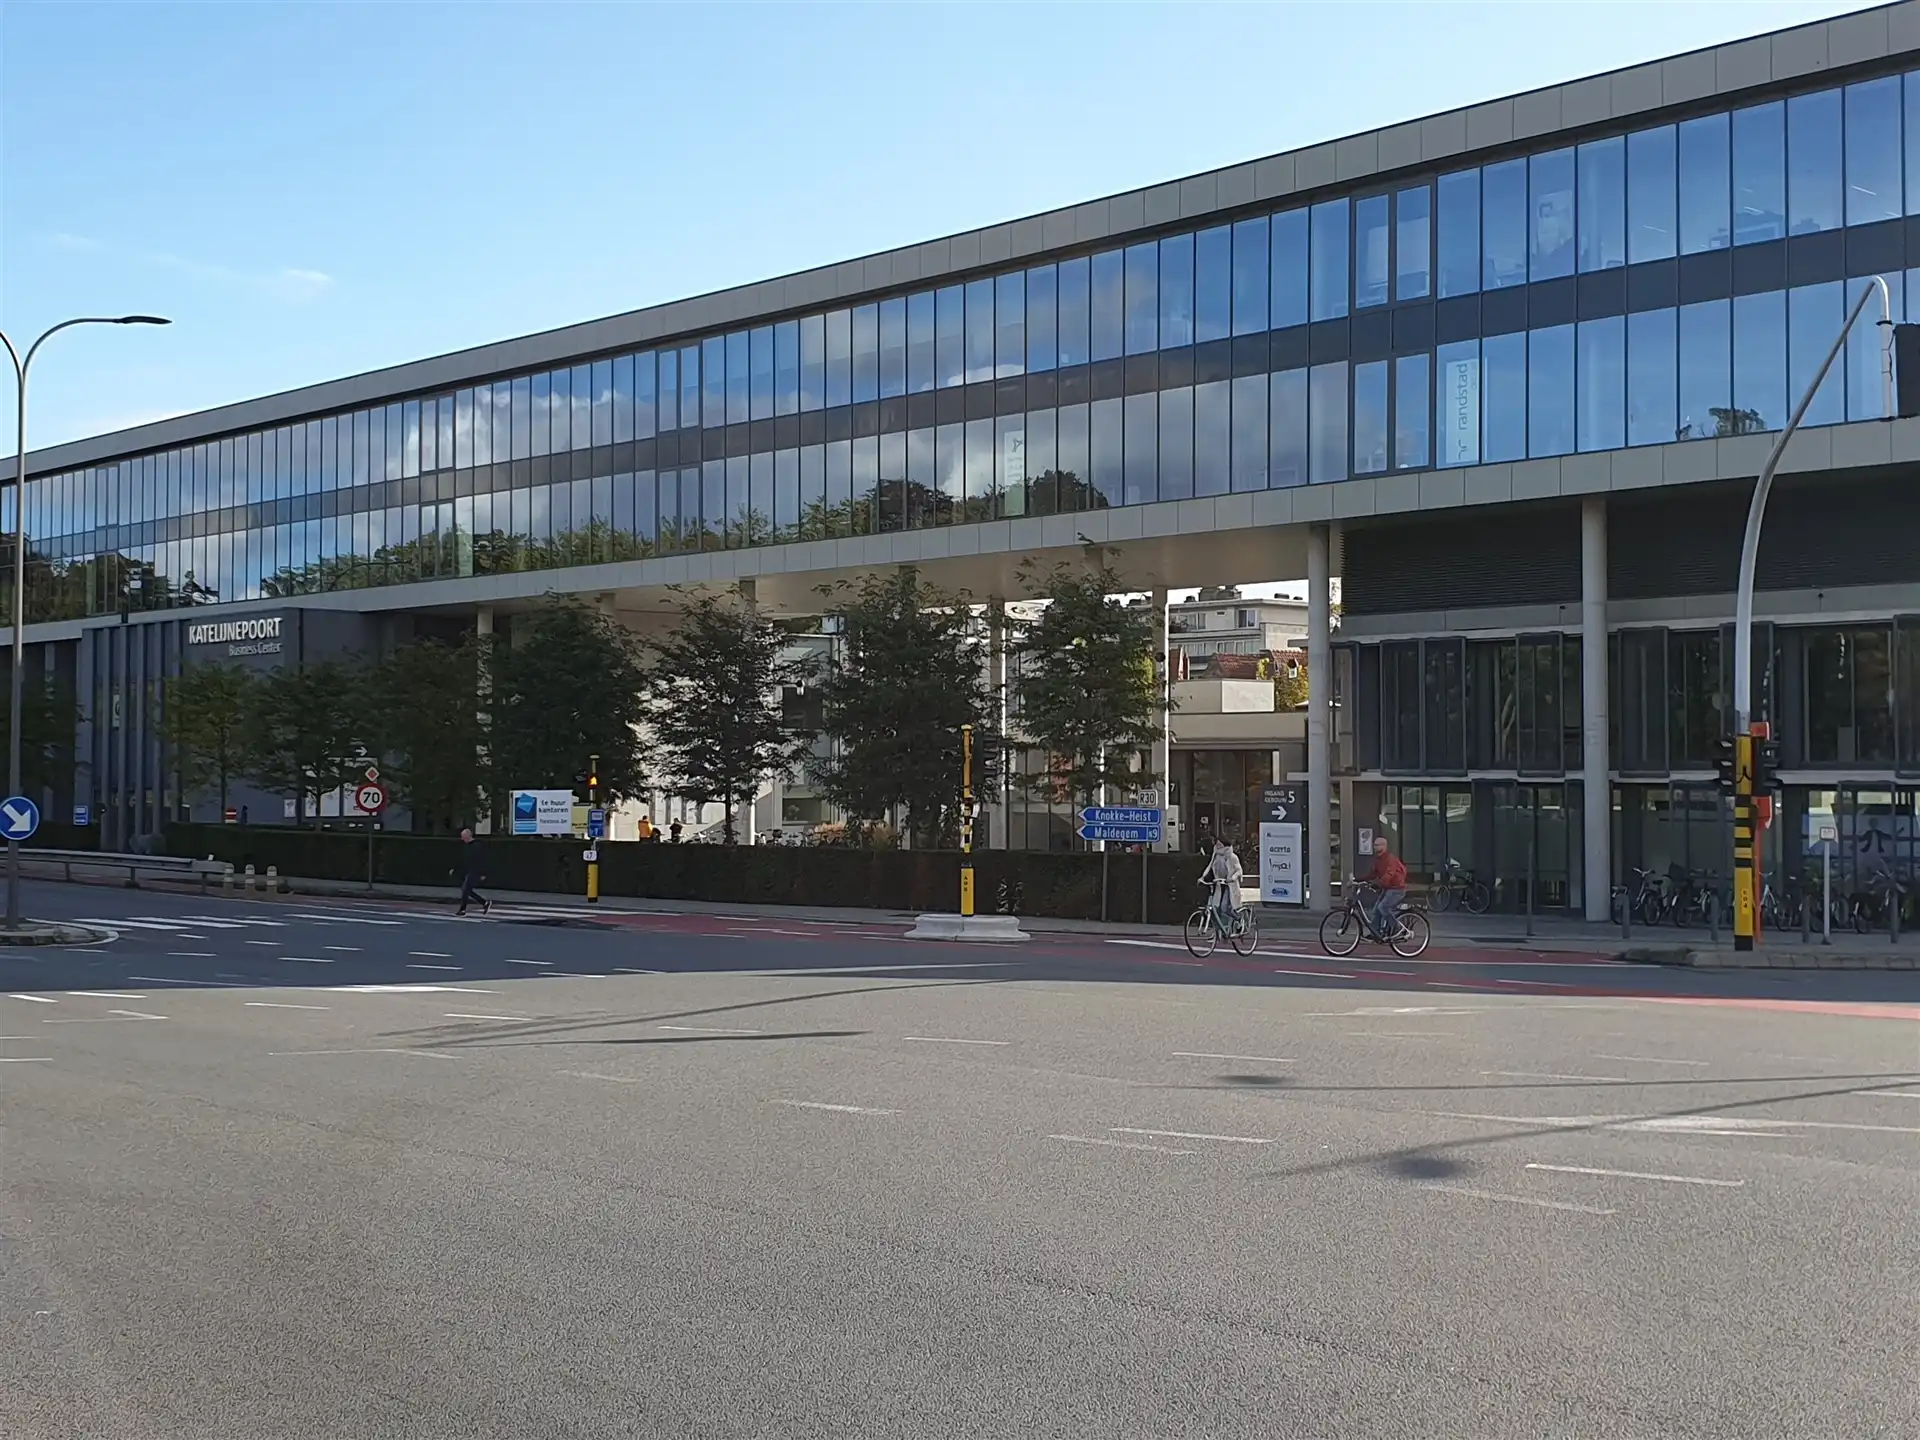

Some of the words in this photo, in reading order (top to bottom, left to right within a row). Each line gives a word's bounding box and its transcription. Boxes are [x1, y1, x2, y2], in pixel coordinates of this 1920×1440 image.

[1456, 363, 1468, 431] randstad
[189, 617, 283, 645] KATELIJNEPOORT
[229, 644, 257, 656] Business
[258, 641, 282, 653] Center
[363, 791, 381, 804] 70
[1140, 792, 1156, 805] R30
[1288, 790, 1296, 804] 5
[538, 806, 569, 814] kantoren
[1095, 809, 1152, 821] Knokke-Heist
[1094, 827, 1139, 841] Maldegem
[1148, 829, 1159, 839] N9
